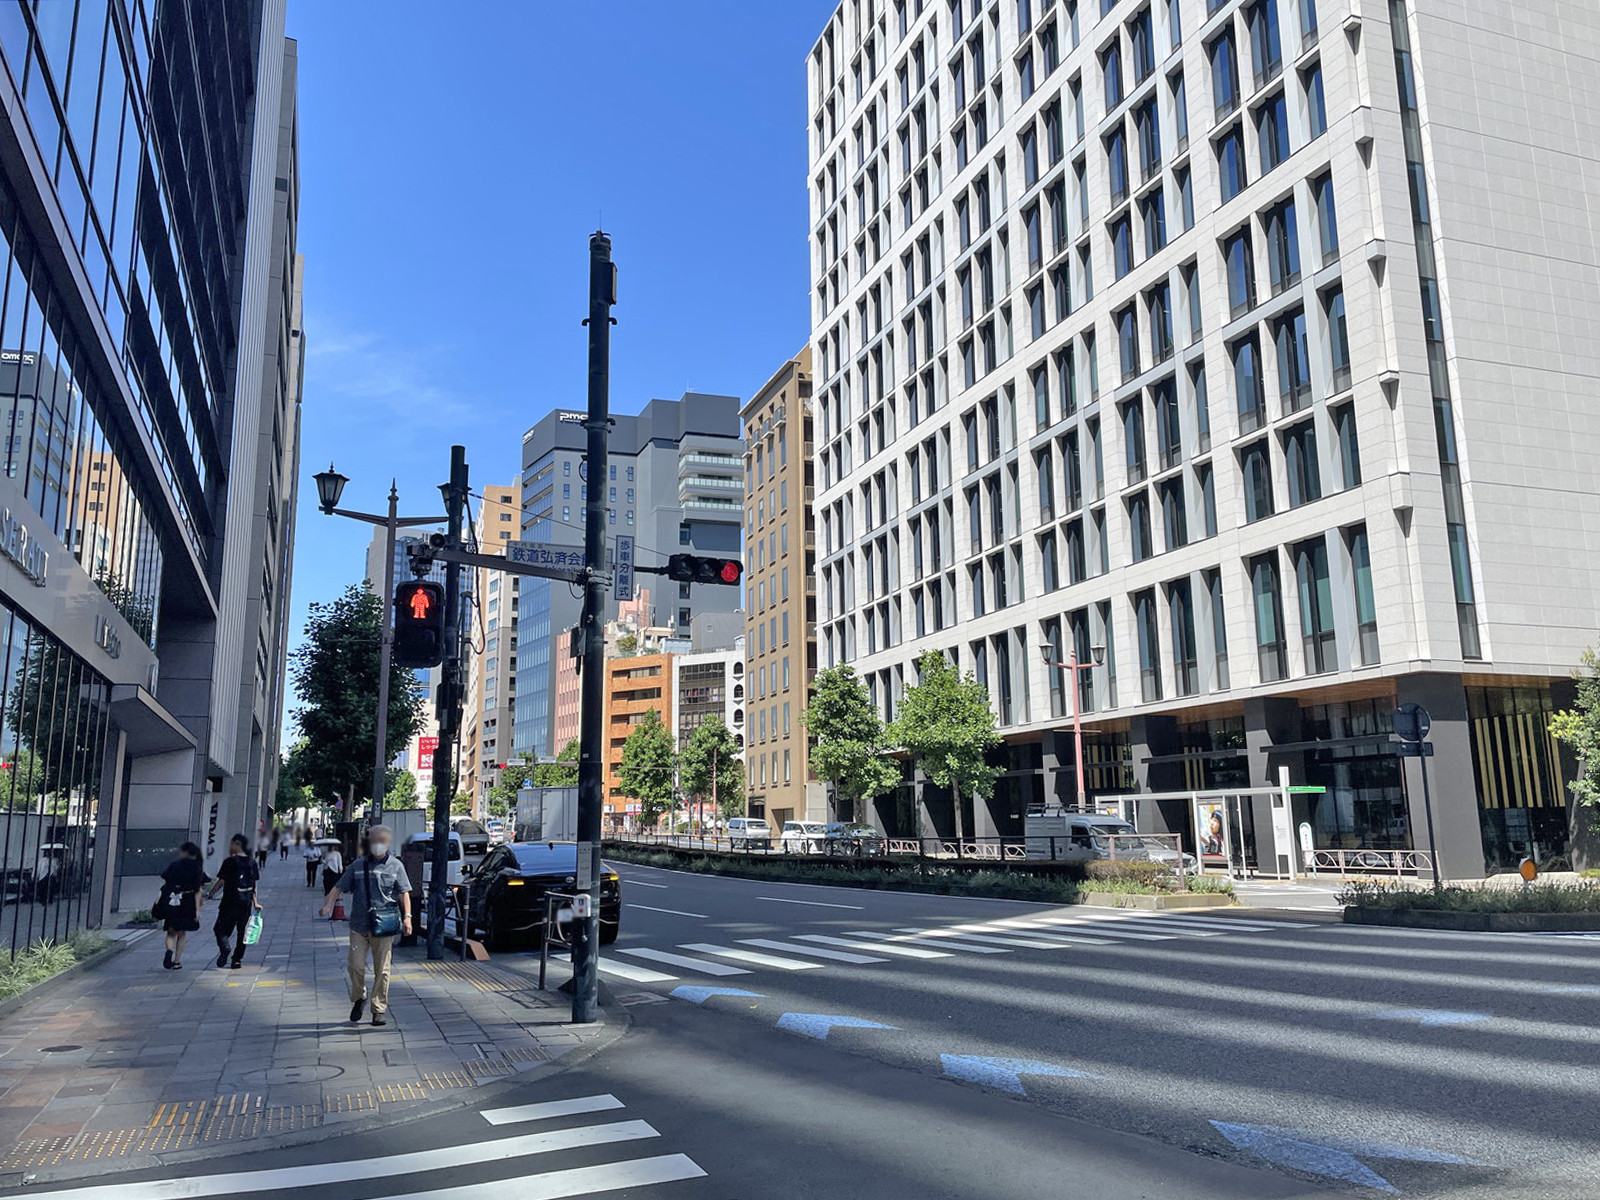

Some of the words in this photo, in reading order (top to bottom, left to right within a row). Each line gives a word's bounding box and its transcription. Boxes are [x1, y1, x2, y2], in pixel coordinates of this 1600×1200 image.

[618, 540, 631, 598] 歩車分離式
